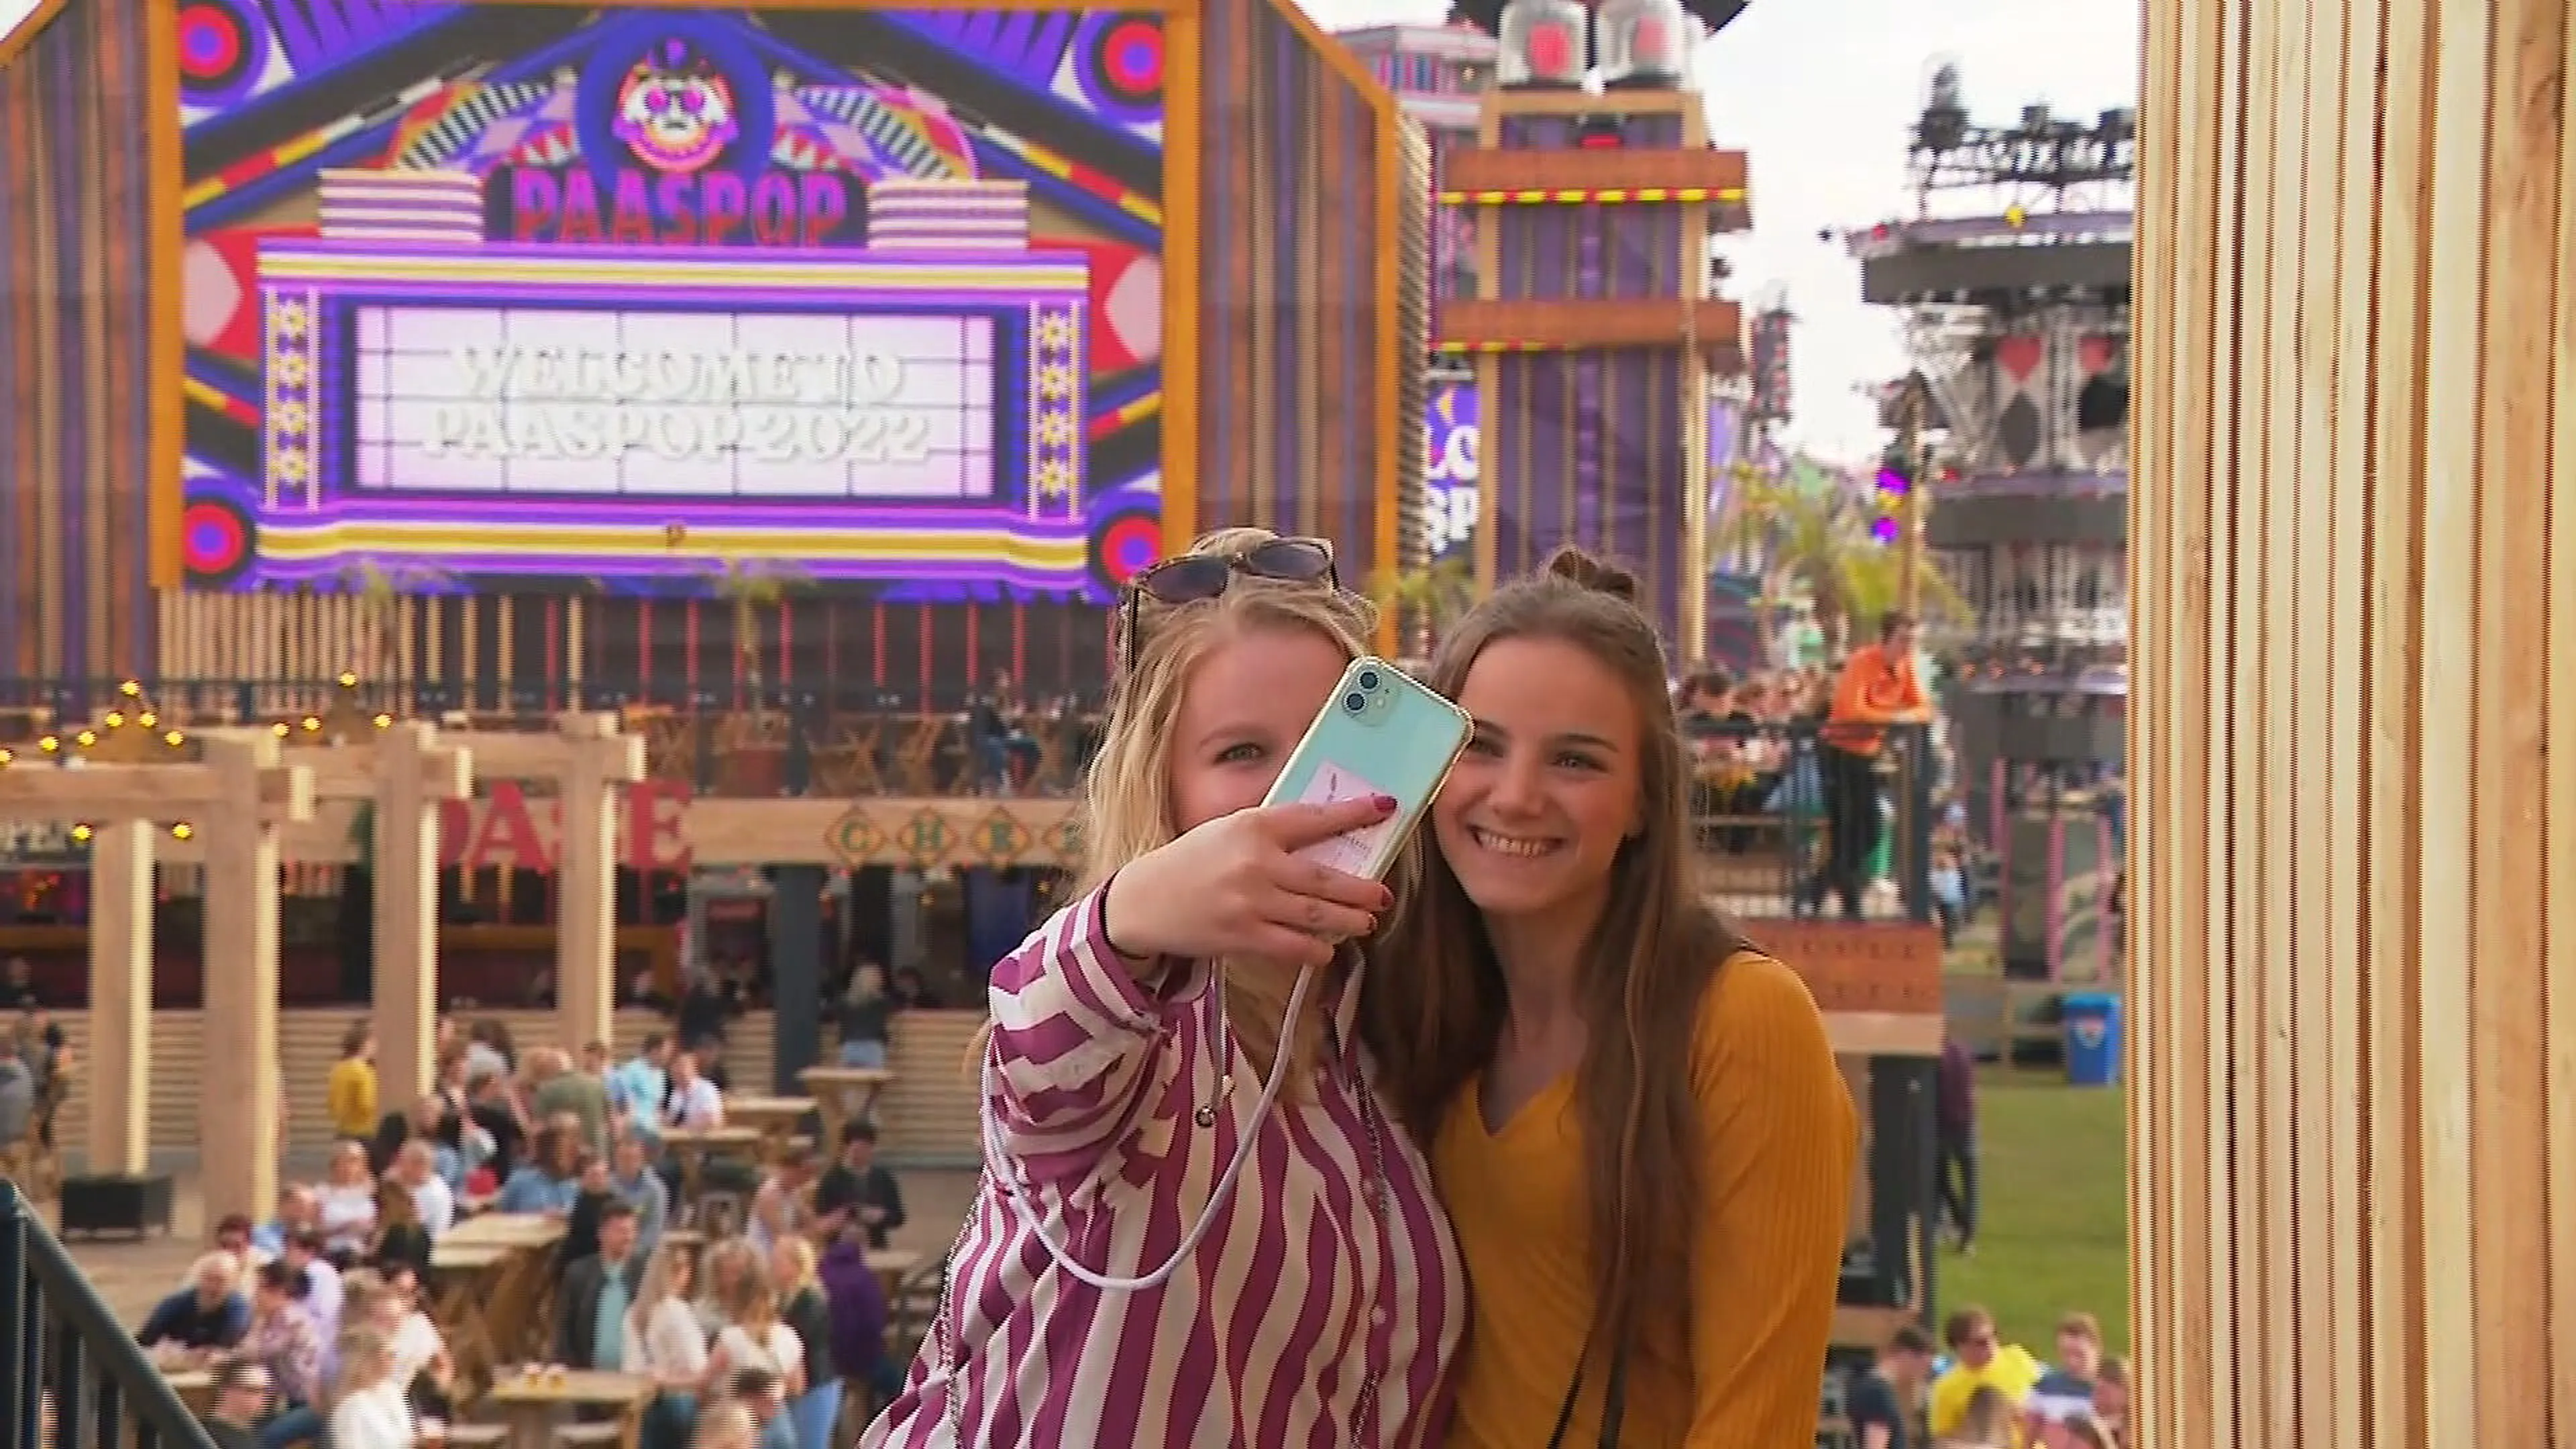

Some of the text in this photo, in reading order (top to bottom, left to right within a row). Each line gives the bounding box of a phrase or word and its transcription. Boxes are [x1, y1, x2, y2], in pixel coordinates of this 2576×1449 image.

[513, 169, 848, 247] PAASPOP
[451, 345, 904, 407] WELCOME TO
[425, 407, 931, 463] PAASPOP 2022
